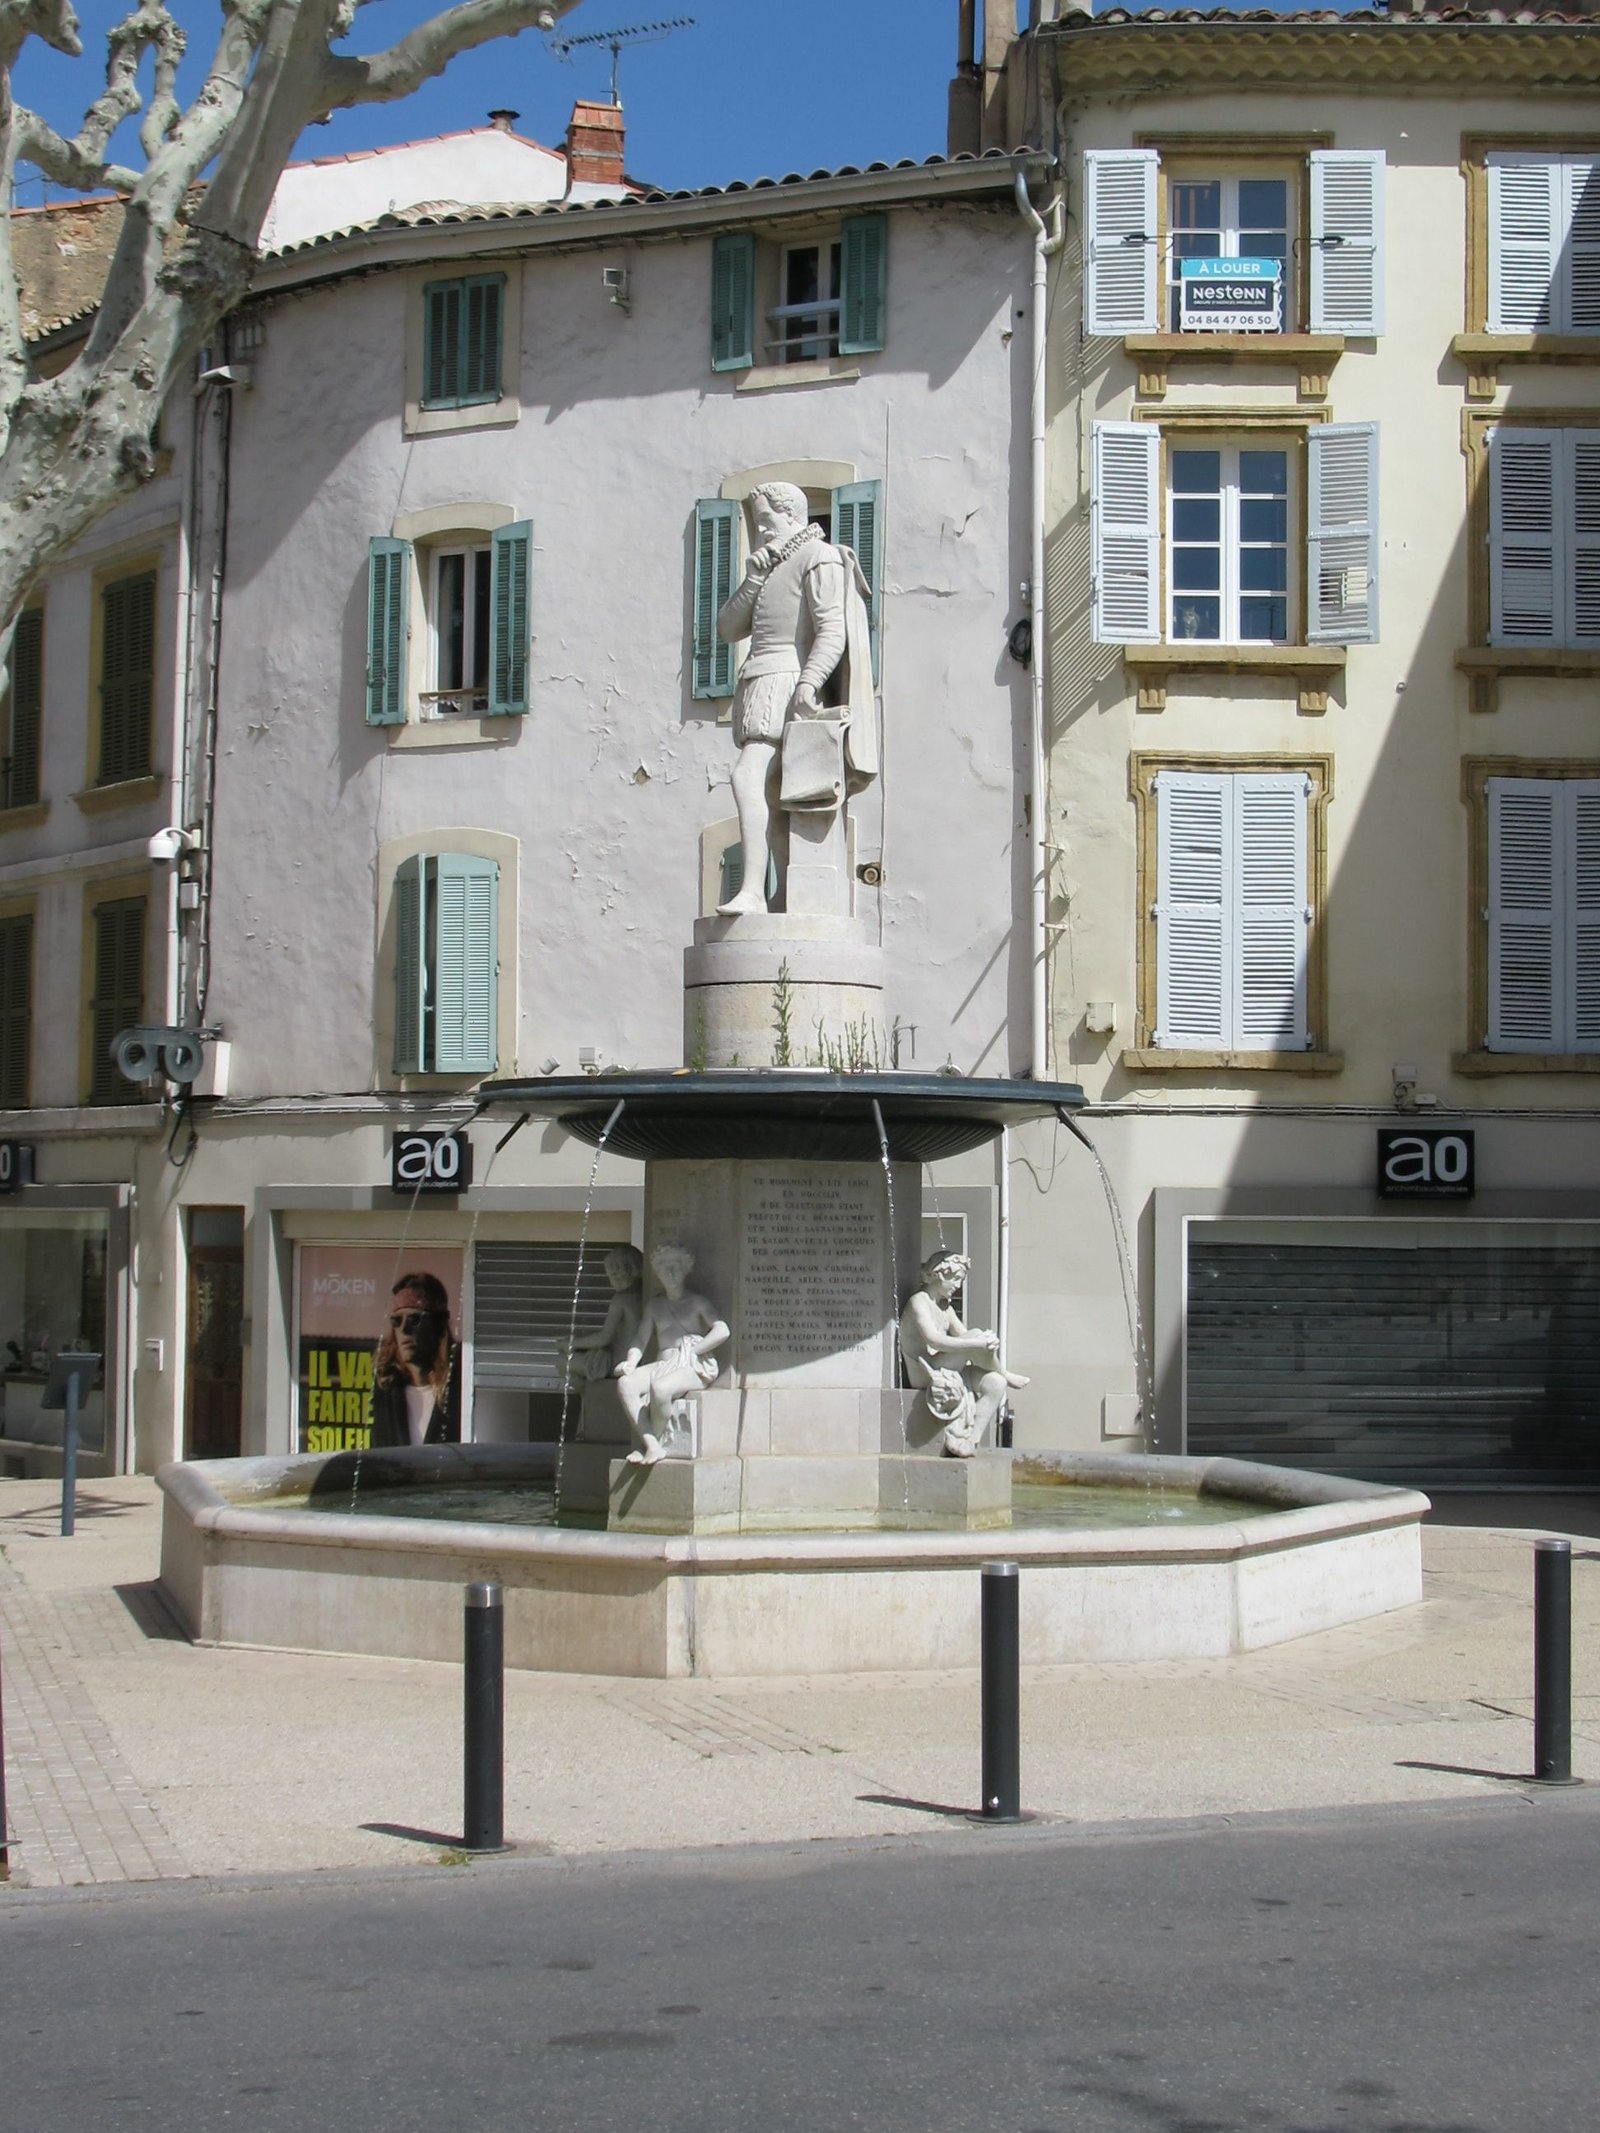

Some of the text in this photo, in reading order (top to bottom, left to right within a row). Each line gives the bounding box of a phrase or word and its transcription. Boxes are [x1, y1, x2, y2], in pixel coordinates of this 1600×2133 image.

[1199, 261, 1261, 274] À LOUER
[1188, 315, 1272, 325] 04 84 47 06 50
[308, 1350, 374, 1390] IL VA
[308, 1390, 374, 1425] FAIRE
